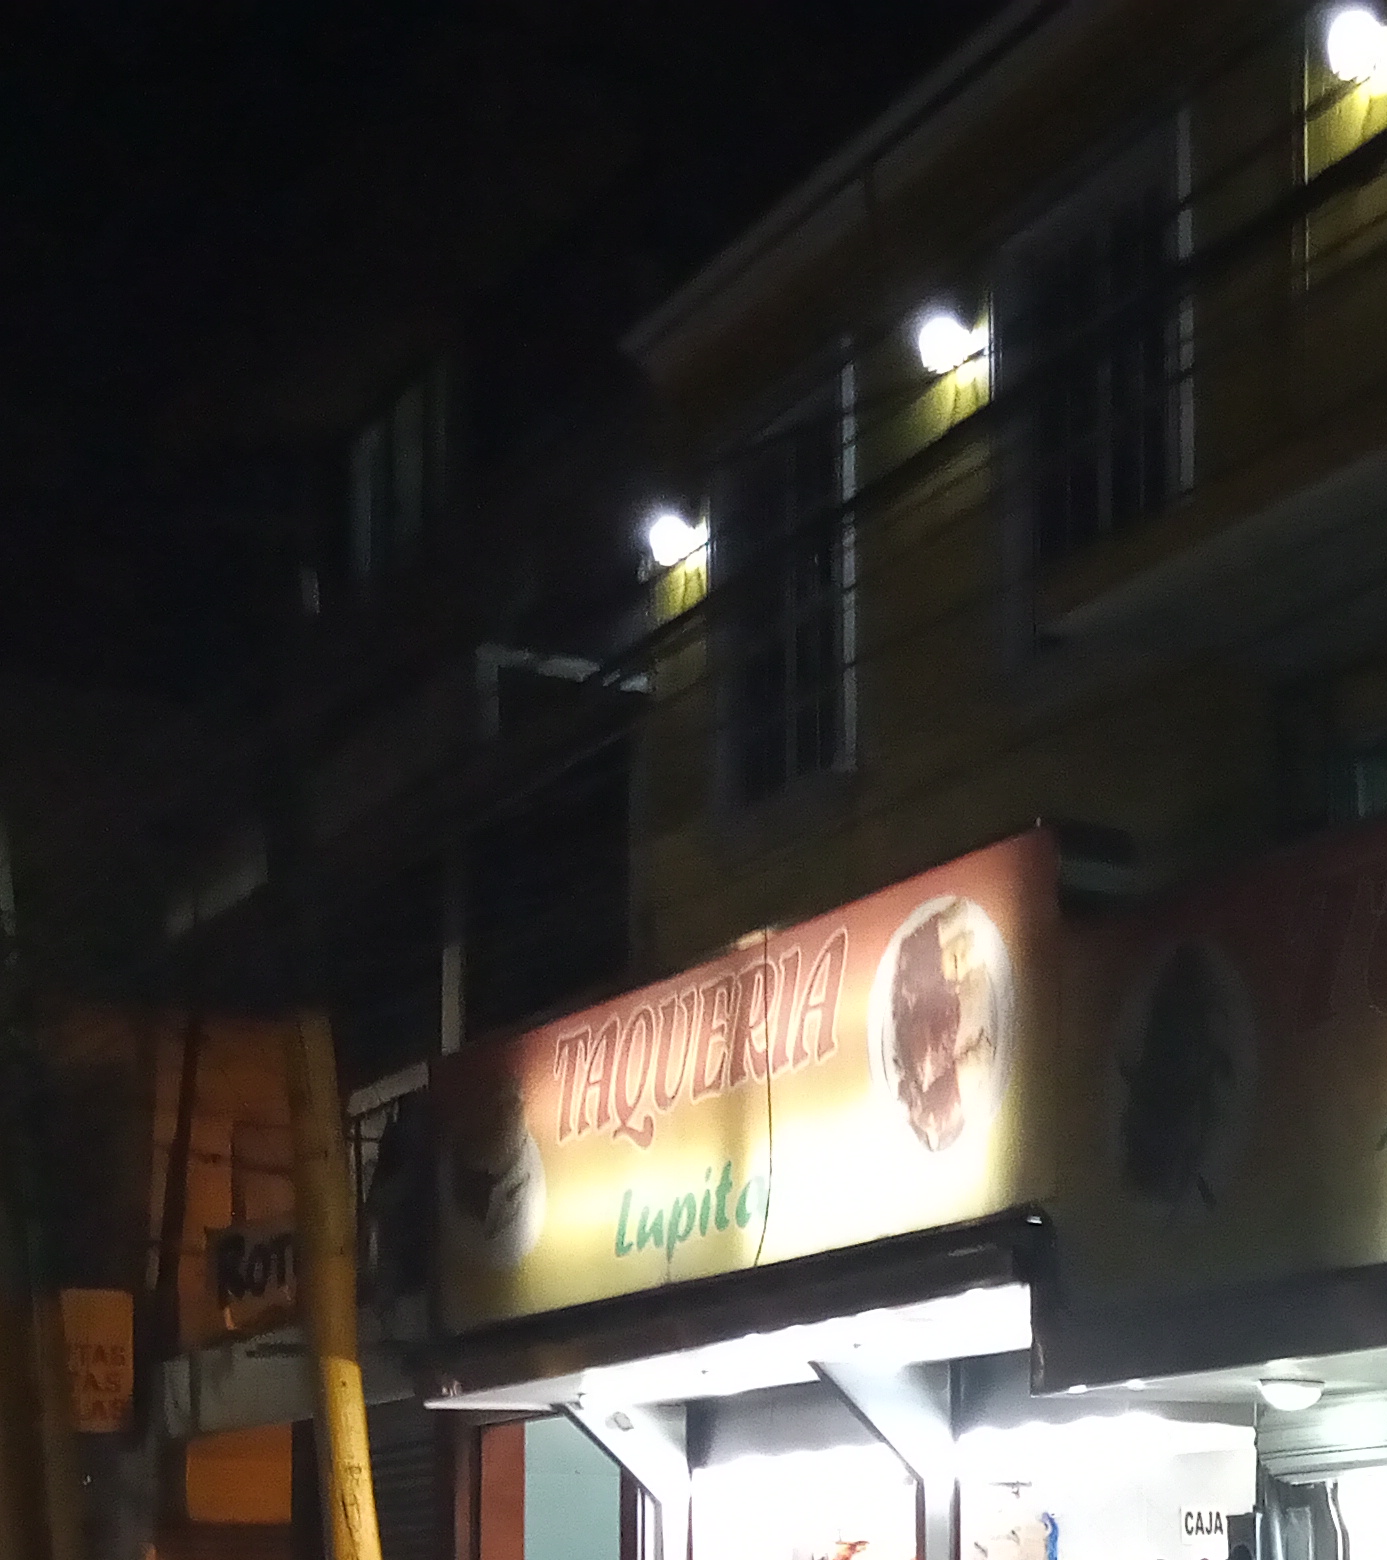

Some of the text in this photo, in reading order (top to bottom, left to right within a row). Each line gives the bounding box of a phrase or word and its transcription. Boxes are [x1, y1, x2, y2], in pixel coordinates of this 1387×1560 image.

[553, 927, 850, 1150] TAQUERIA
[613, 1160, 768, 1262] Lupita
[1184, 1511, 1224, 1536] CAJA
